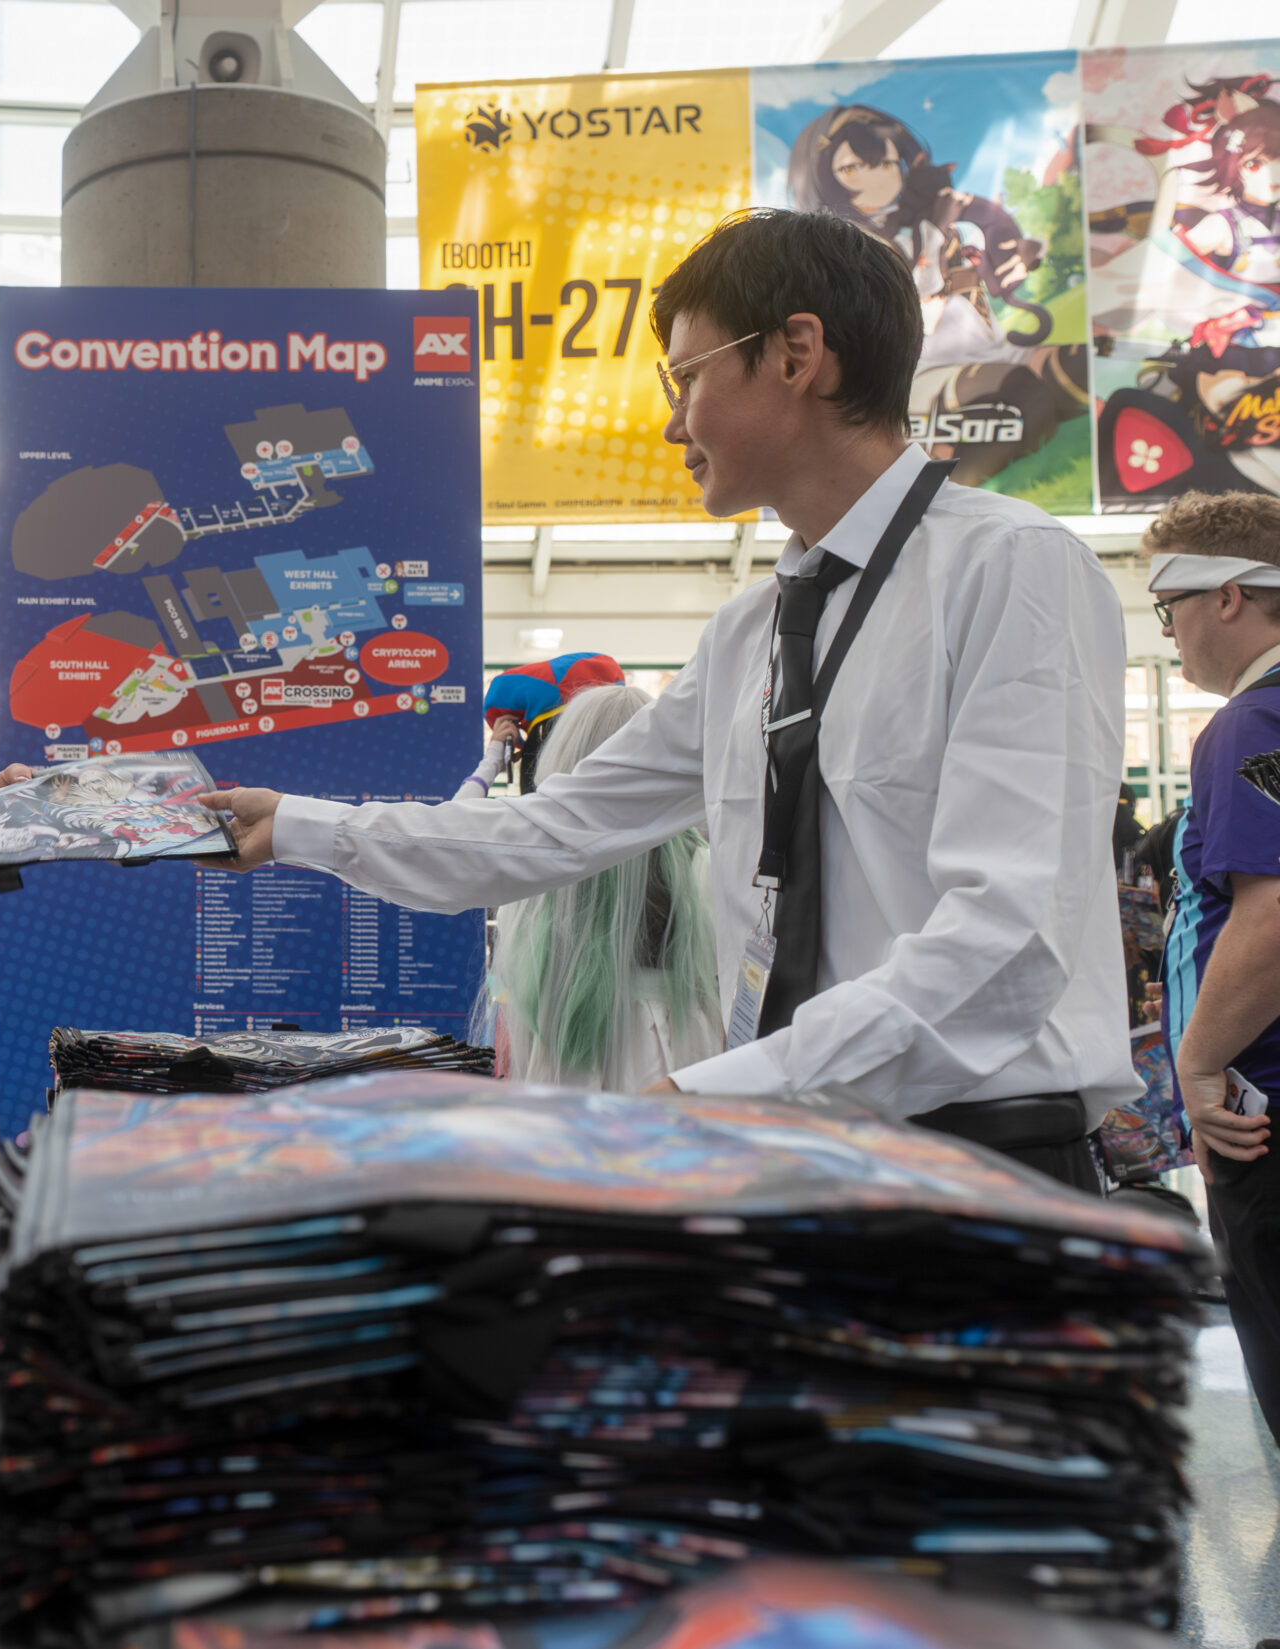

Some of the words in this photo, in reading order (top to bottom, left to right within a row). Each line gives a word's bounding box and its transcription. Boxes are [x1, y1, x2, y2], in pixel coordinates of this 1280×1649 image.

[522, 104, 702, 140] YOSTAR
[445, 278, 669, 361] H-27
[415, 332, 469, 356] AX
[15, 329, 278, 373] Convention
[287, 332, 388, 382] Map
[413, 377, 444, 387] ANIME
[19, 452, 46, 461] UPPER
[47, 452, 73, 461] LEVEL
[284, 570, 312, 579] WEST
[313, 570, 339, 580] HALL
[290, 581, 333, 590] EXHIBITS
[17, 597, 39, 606] MAIN
[40, 597, 70, 606] EXHIBIT
[71, 597, 96, 606] LEVEL
[164, 599, 178, 620] PICO
[174, 617, 188, 639] BLVD
[372, 648, 437, 658] CRYPTO.COM
[50, 660, 84, 670] SOUTH
[85, 660, 110, 670] HALL
[387, 659, 422, 669] ARENA
[58, 671, 101, 681] EXHIBITS
[284, 687, 351, 699] CROSSING
[196, 724, 238, 739] FIGUEROA
[238, 722, 250, 732] ST
[193, 1002, 225, 1010] Services
[340, 1004, 376, 1012] Amenities
